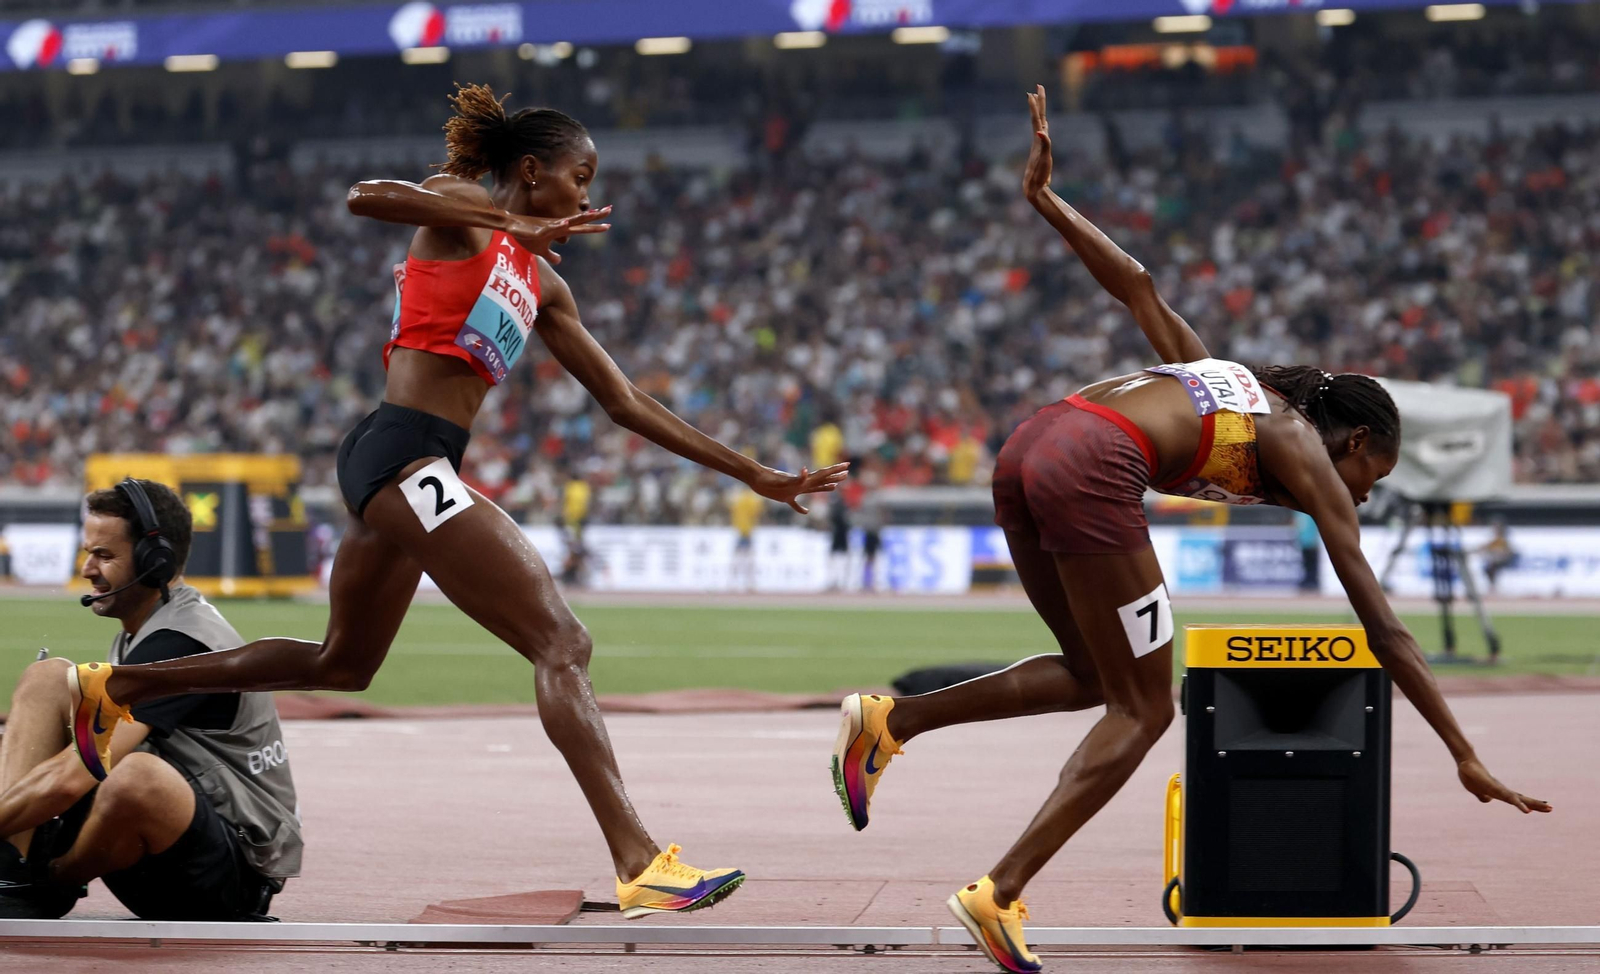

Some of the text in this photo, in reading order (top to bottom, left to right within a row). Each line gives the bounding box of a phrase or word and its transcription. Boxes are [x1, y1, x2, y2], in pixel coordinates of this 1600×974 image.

[494, 311, 522, 361] YAVI
[1200, 371, 1238, 406] UTAI
[417, 475, 457, 517] 2
[1135, 599, 1159, 644] 7
[1226, 636, 1356, 662] SEIKO
[247, 740, 288, 775] BRO
